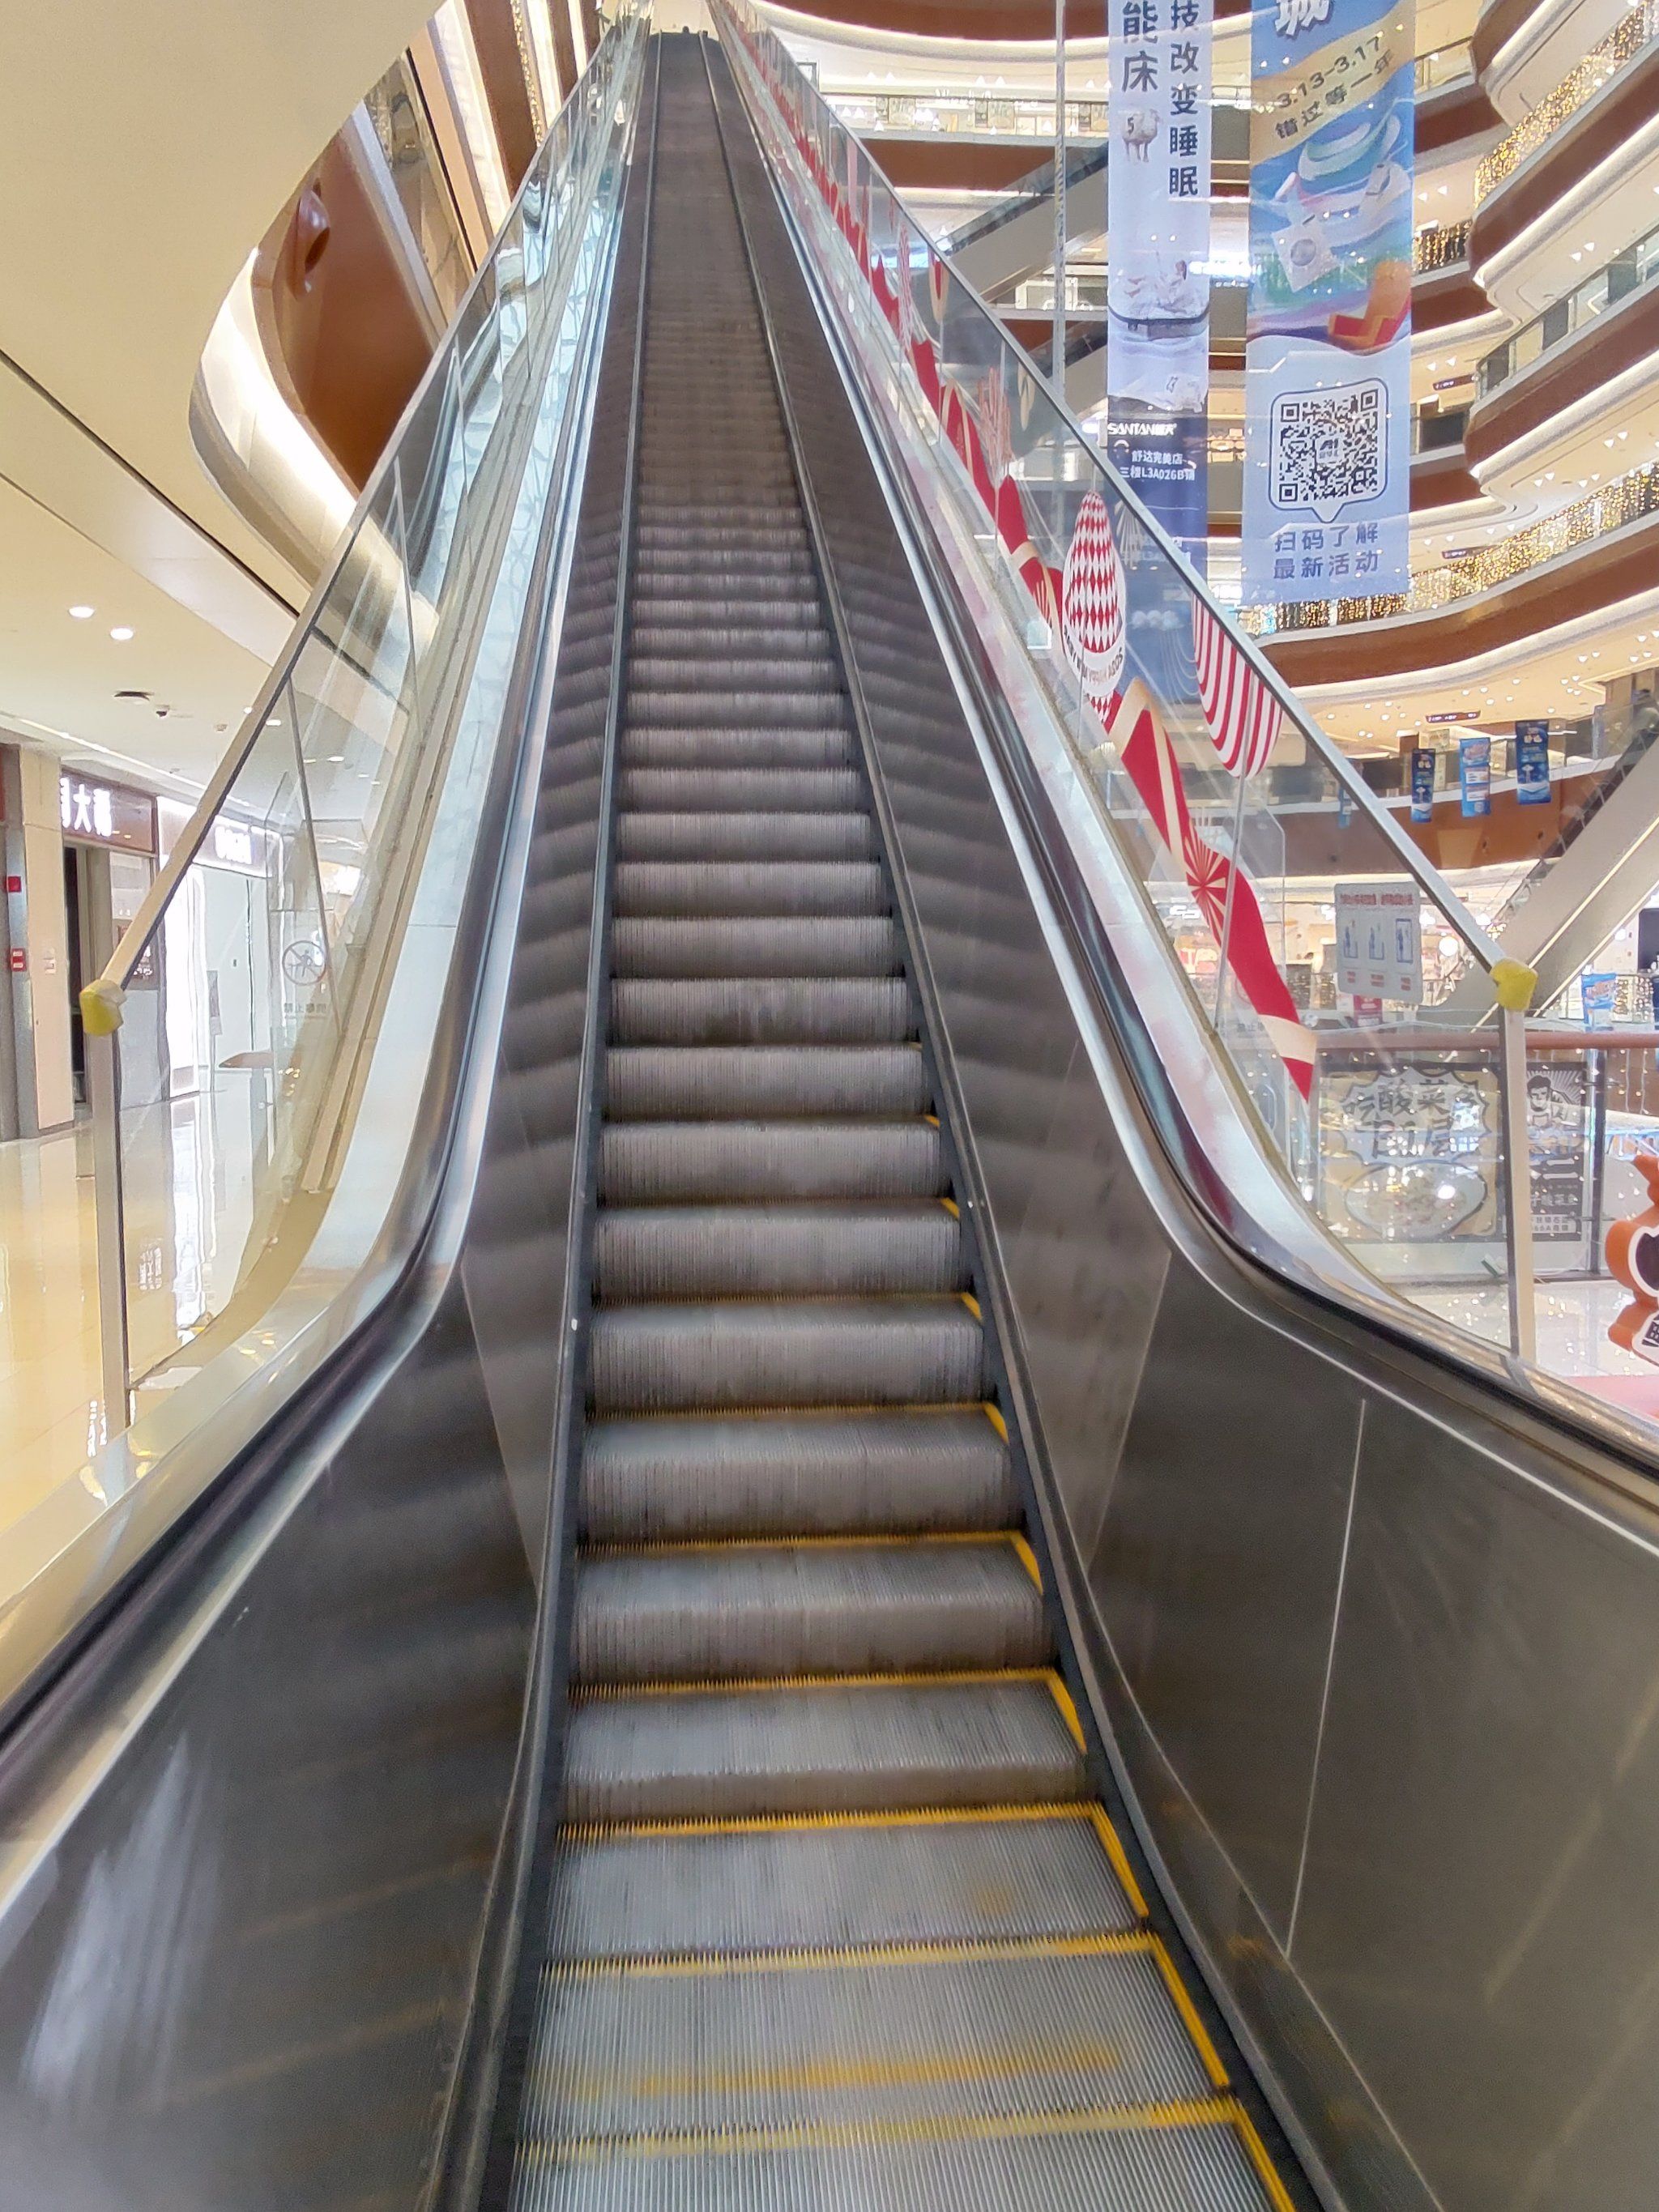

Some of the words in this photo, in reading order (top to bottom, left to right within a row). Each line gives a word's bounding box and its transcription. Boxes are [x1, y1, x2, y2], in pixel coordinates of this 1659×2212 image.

[1122, 0, 1158, 92] 能床
[1169, 0, 1200, 197] 技改变睡眠
[1275, 49, 1396, 139] 错过等一年
[1273, 551, 1378, 579] 最新活动
[1274, 522, 1378, 552] 扫码了解
